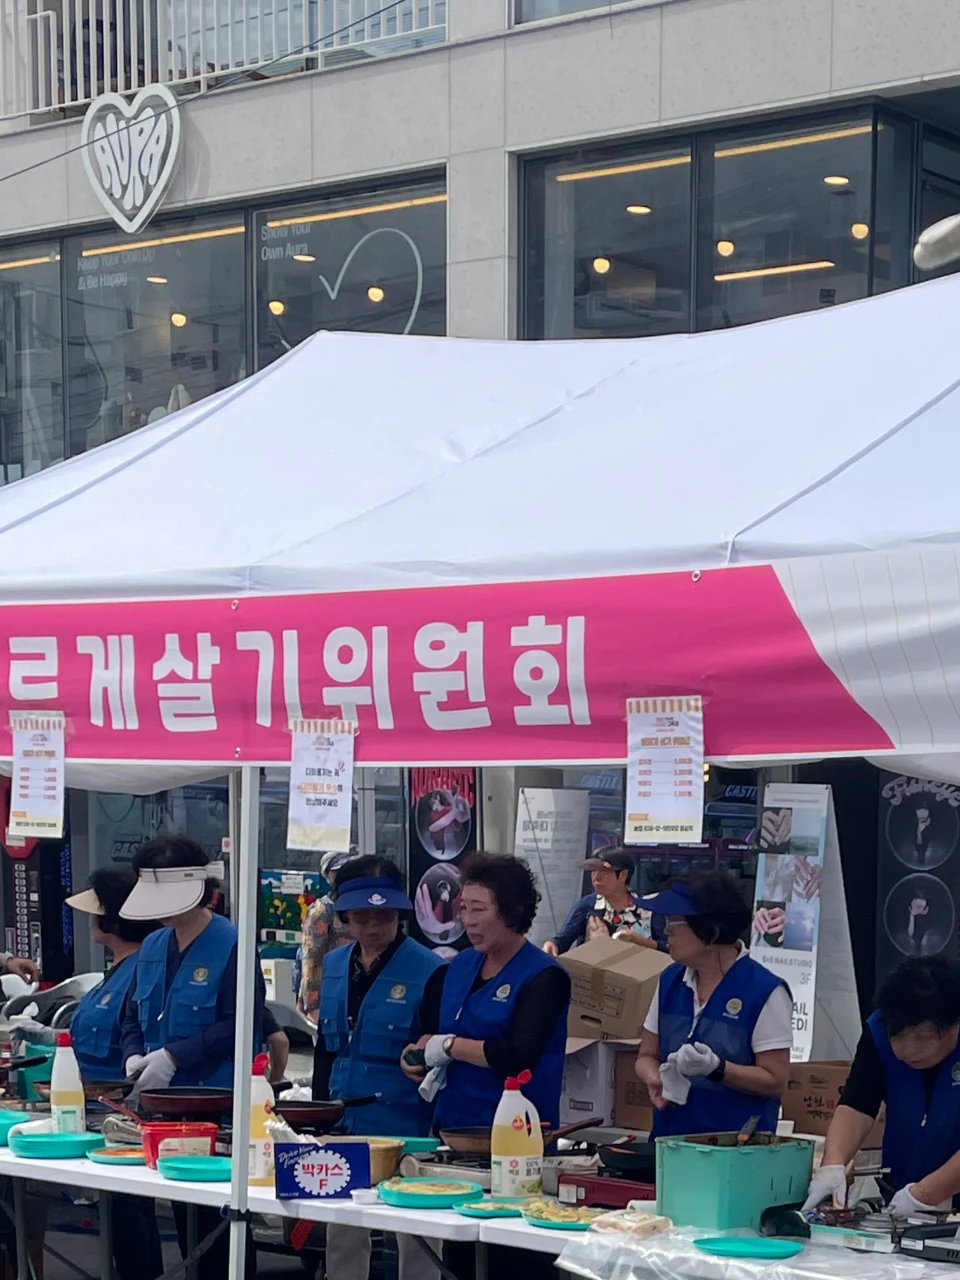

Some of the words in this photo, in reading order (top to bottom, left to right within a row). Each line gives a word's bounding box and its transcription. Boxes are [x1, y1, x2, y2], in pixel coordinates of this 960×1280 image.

[261, 246, 284, 261] Own
[285, 242, 309, 259] Aura
[87, 275, 99, 289] Be
[100, 271, 128, 288] Happy
[800, 972, 812, 986] 3F
[791, 1001, 809, 1016] AIL
[790, 1017, 808, 1032] EDI
[302, 1163, 344, 1177] 박카스
[319, 1179, 328, 1190] F
